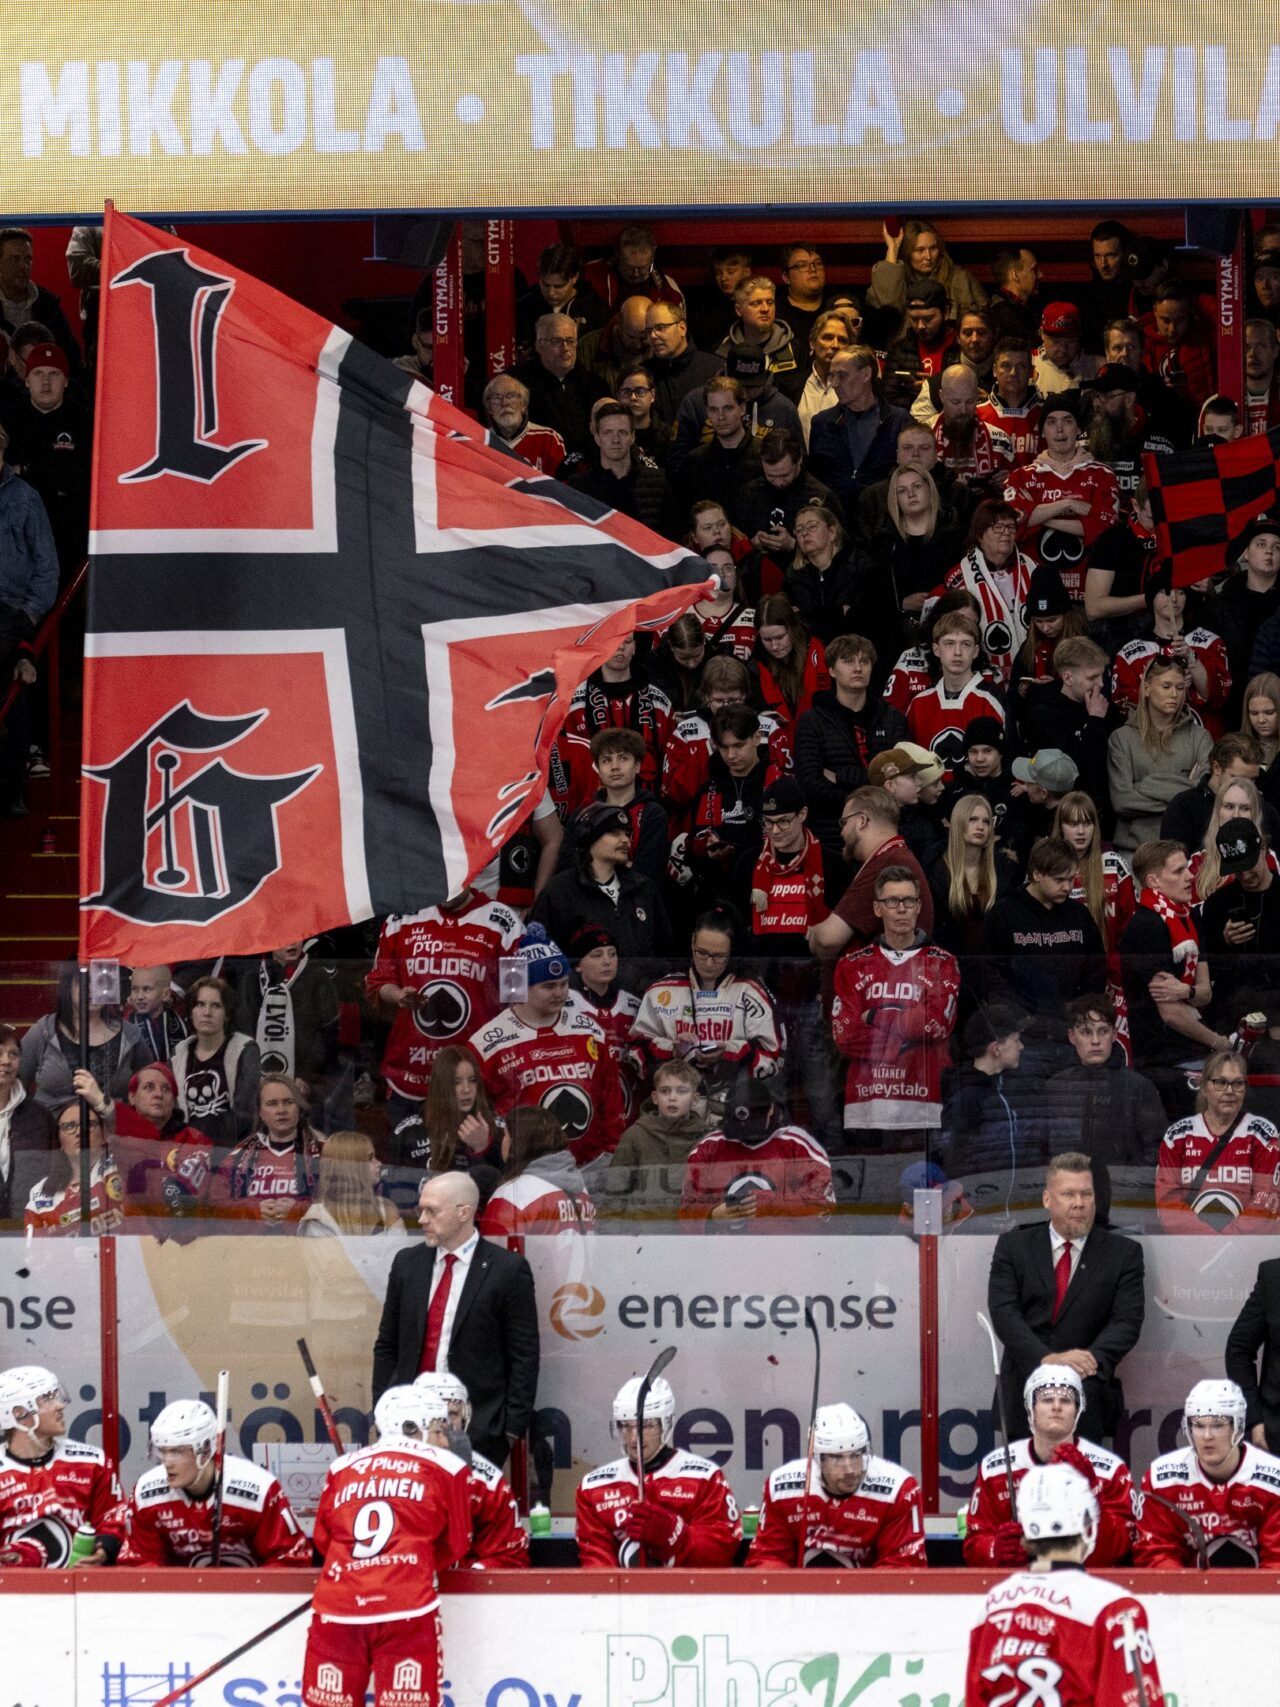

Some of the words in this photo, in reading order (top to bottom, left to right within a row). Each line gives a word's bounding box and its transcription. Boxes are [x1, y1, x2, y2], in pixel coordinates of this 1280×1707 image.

[20, 56, 427, 158] MIKKOLA
[1013, 930, 1042, 946] IRON
[1042, 929, 1084, 946] MAIDEN
[405, 957, 487, 984] BOLIDEN
[618, 1293, 896, 1329] enersense
[371, 1457, 421, 1474] Plugit
[1156, 1462, 1189, 1473] WESTAS
[229, 1478, 261, 1491] WESTAS
[334, 1477, 425, 1508] LIPIÄINEN
[660, 1490, 695, 1500] OLMAR
[843, 1512, 879, 1524] OLMAR
[352, 1499, 395, 1559] 9
